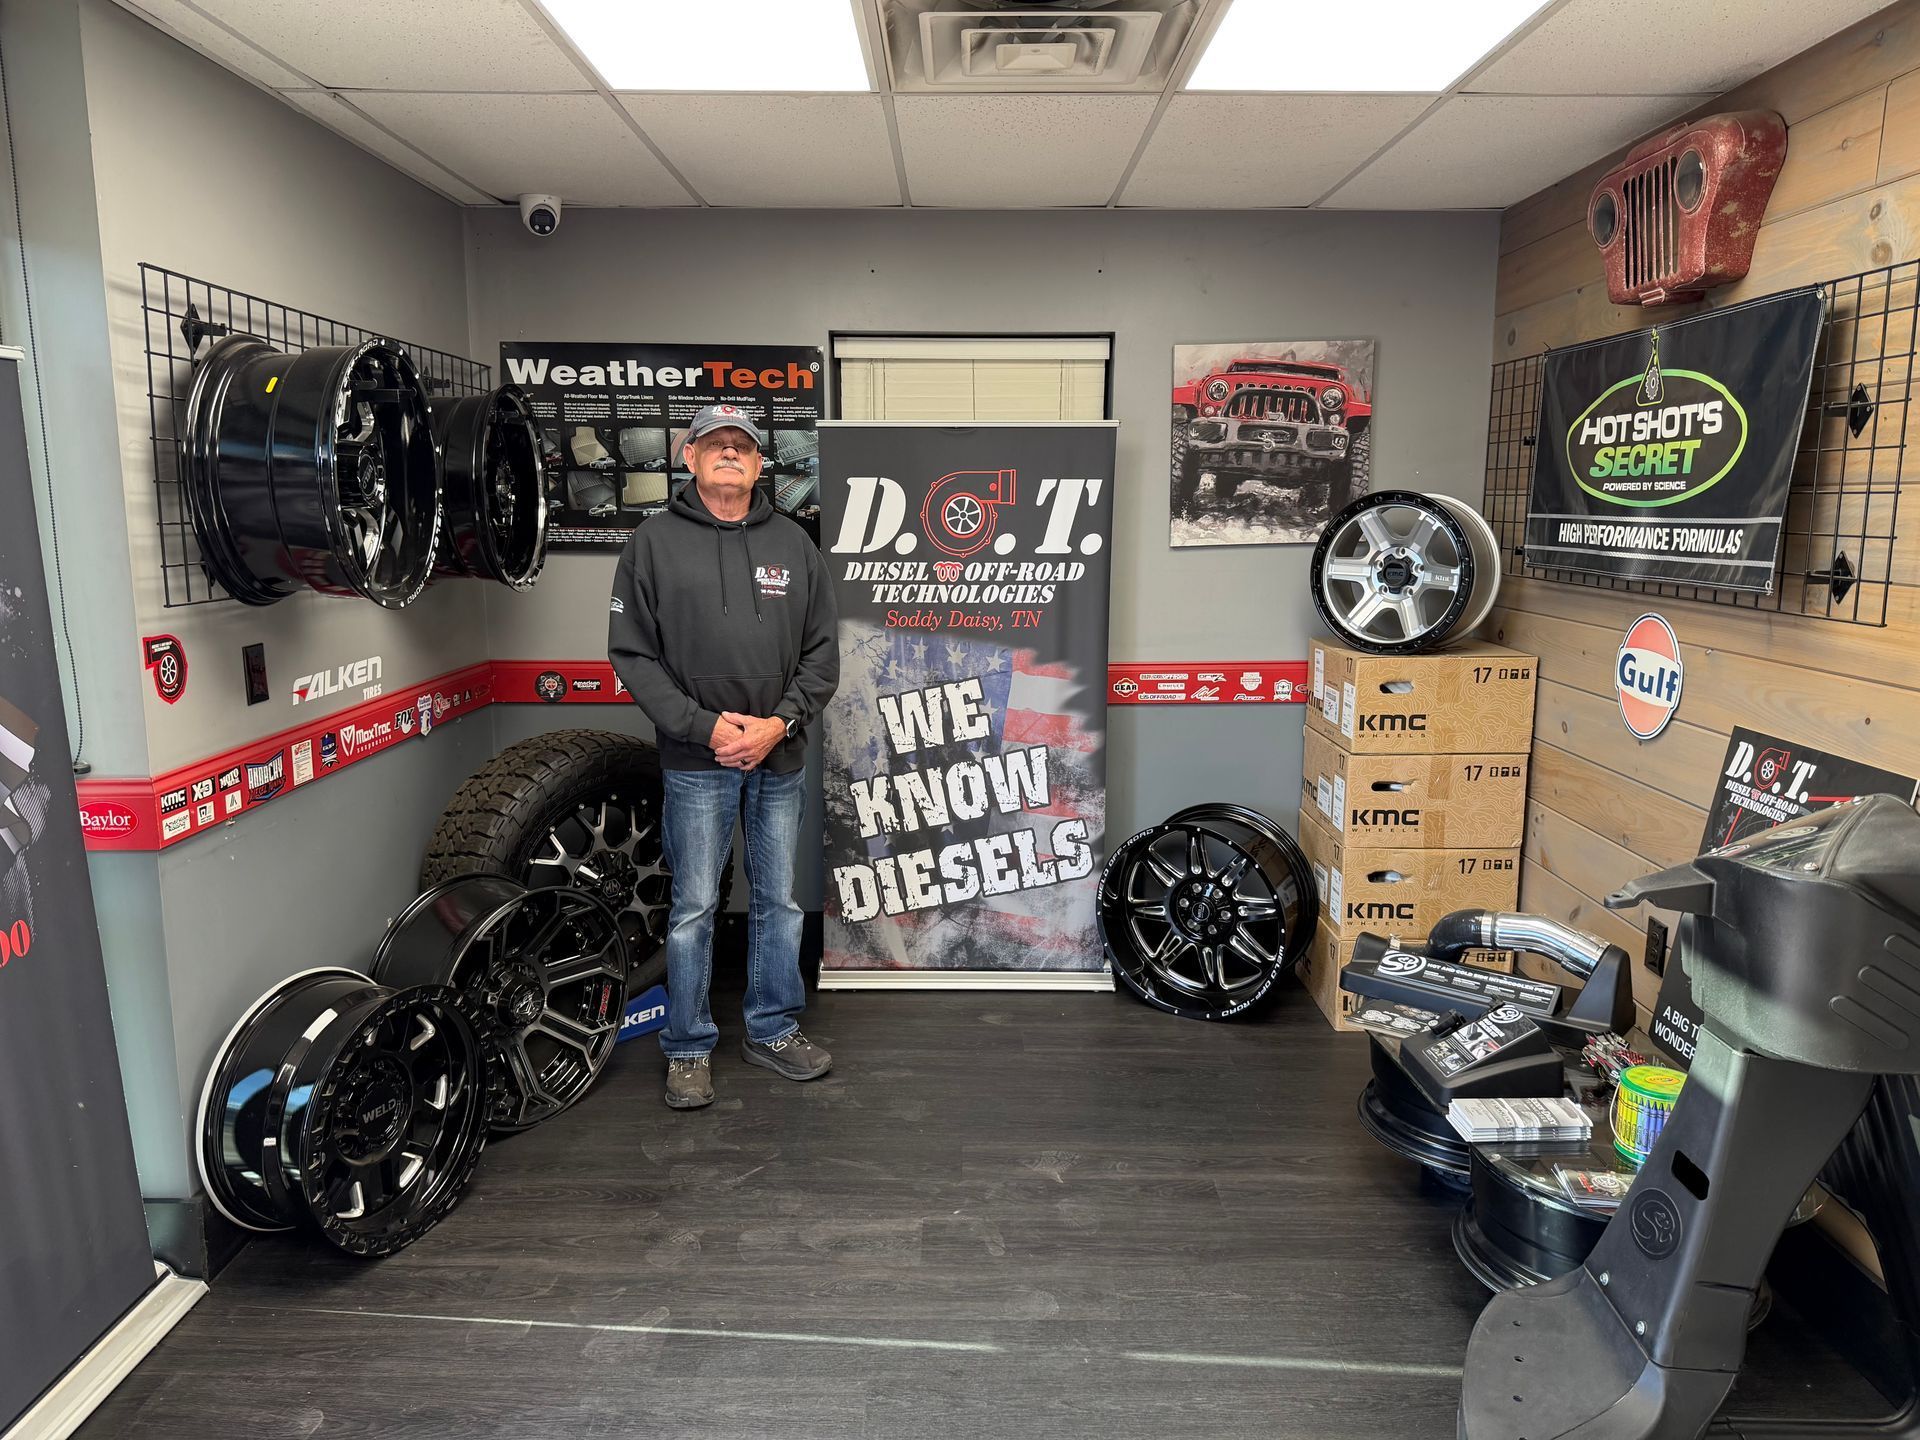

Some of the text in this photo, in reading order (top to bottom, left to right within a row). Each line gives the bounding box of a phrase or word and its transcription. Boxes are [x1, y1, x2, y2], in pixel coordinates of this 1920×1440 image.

[1579, 400, 1723, 445] HOT SHOT'S
[1589, 439, 1702, 478] SECRET
[1602, 481, 1687, 491] POWERED BY SCIENCE
[1558, 522, 1744, 555] HIGH PERFORMANCE FORMULAS
[843, 561, 1086, 582] DIESEL OFF-ROAD
[871, 584, 1057, 605] TECHNOLOGIES
[885, 609, 1043, 631] Soddy Daisy, TN
[1346, 657, 1353, 673] 17
[1473, 667, 1492, 684] 17
[1619, 652, 1679, 702] Gulf
[292, 655, 382, 706] FALKEN
[362, 683, 382, 701] TIRES
[1114, 683, 1137, 691] GEAR
[394, 706, 415, 730] FOX
[878, 679, 991, 755] WE
[1359, 714, 1427, 731] KMC
[355, 721, 392, 746] MaxTrac
[247, 755, 284, 790] ANARCHY
[1339, 752, 1345, 771] 17
[1464, 765, 1483, 781] 17
[160, 788, 186, 809] KMC
[850, 745, 1051, 839] KNOW
[1725, 779, 1799, 815] DIESEL OFF-ROAD
[1352, 809, 1420, 826] KMC
[1729, 792, 1788, 823] TECHNOLOGIES
[79, 809, 131, 831] Baylor
[1097, 828, 1154, 900] WELD OFF-ROAD
[1333, 844, 1340, 860] 17
[833, 819, 1094, 924] DIESELS
[1458, 858, 1477, 875] 17
[1347, 902, 1414, 920] KMC
[1330, 942, 1336, 960] 17
[1221, 945, 1285, 1017] WELD OFF-ROAD
[1427, 962, 1441, 970] HOT
[1456, 969, 1473, 977] COLD
[1473, 972, 1489, 981] SIDE
[1489, 976, 1534, 991] INTERCOOLER
[1534, 987, 1554, 995] PIPES
[621, 1004, 665, 1029] KEN
[1662, 1005, 1671, 1021] A
[1671, 1010, 1690, 1033] BIG
[362, 1098, 397, 1124] WELD
